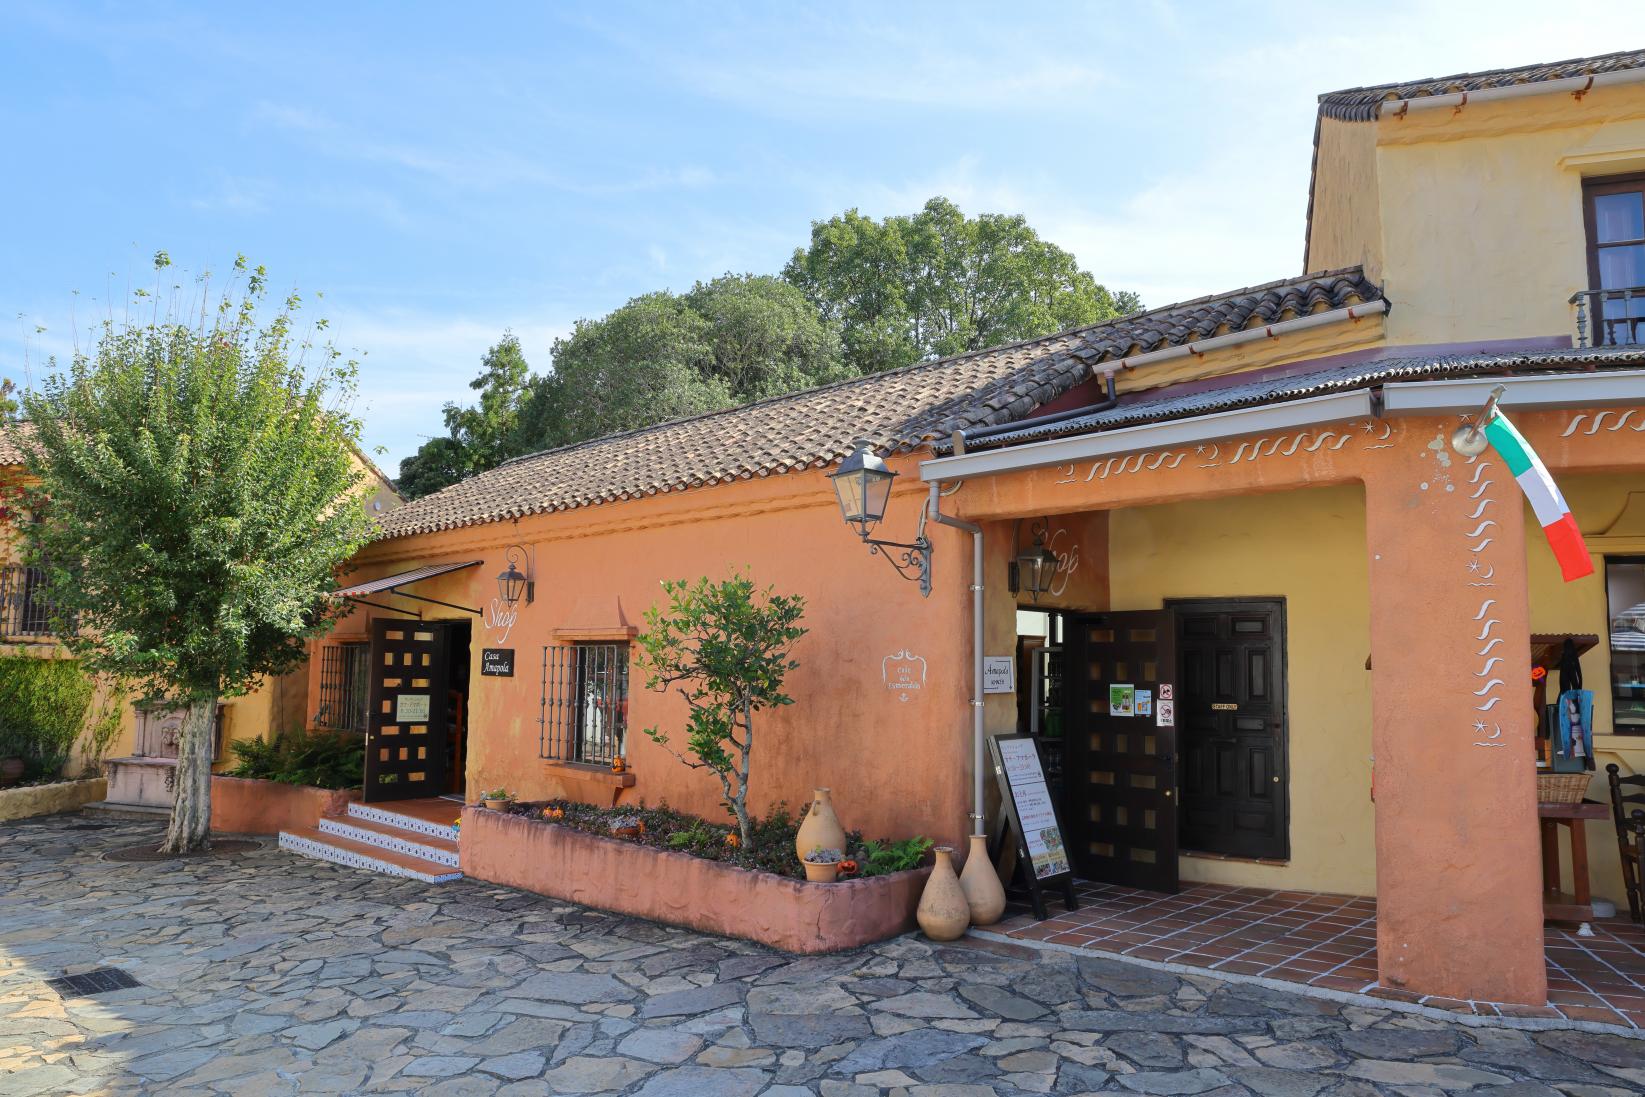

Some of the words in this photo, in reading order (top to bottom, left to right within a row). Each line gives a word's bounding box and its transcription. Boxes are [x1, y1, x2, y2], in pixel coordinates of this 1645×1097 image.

[484, 598, 518, 644] Shop
[483, 651, 500, 661] Casa
[483, 662, 510, 676] Amapola
